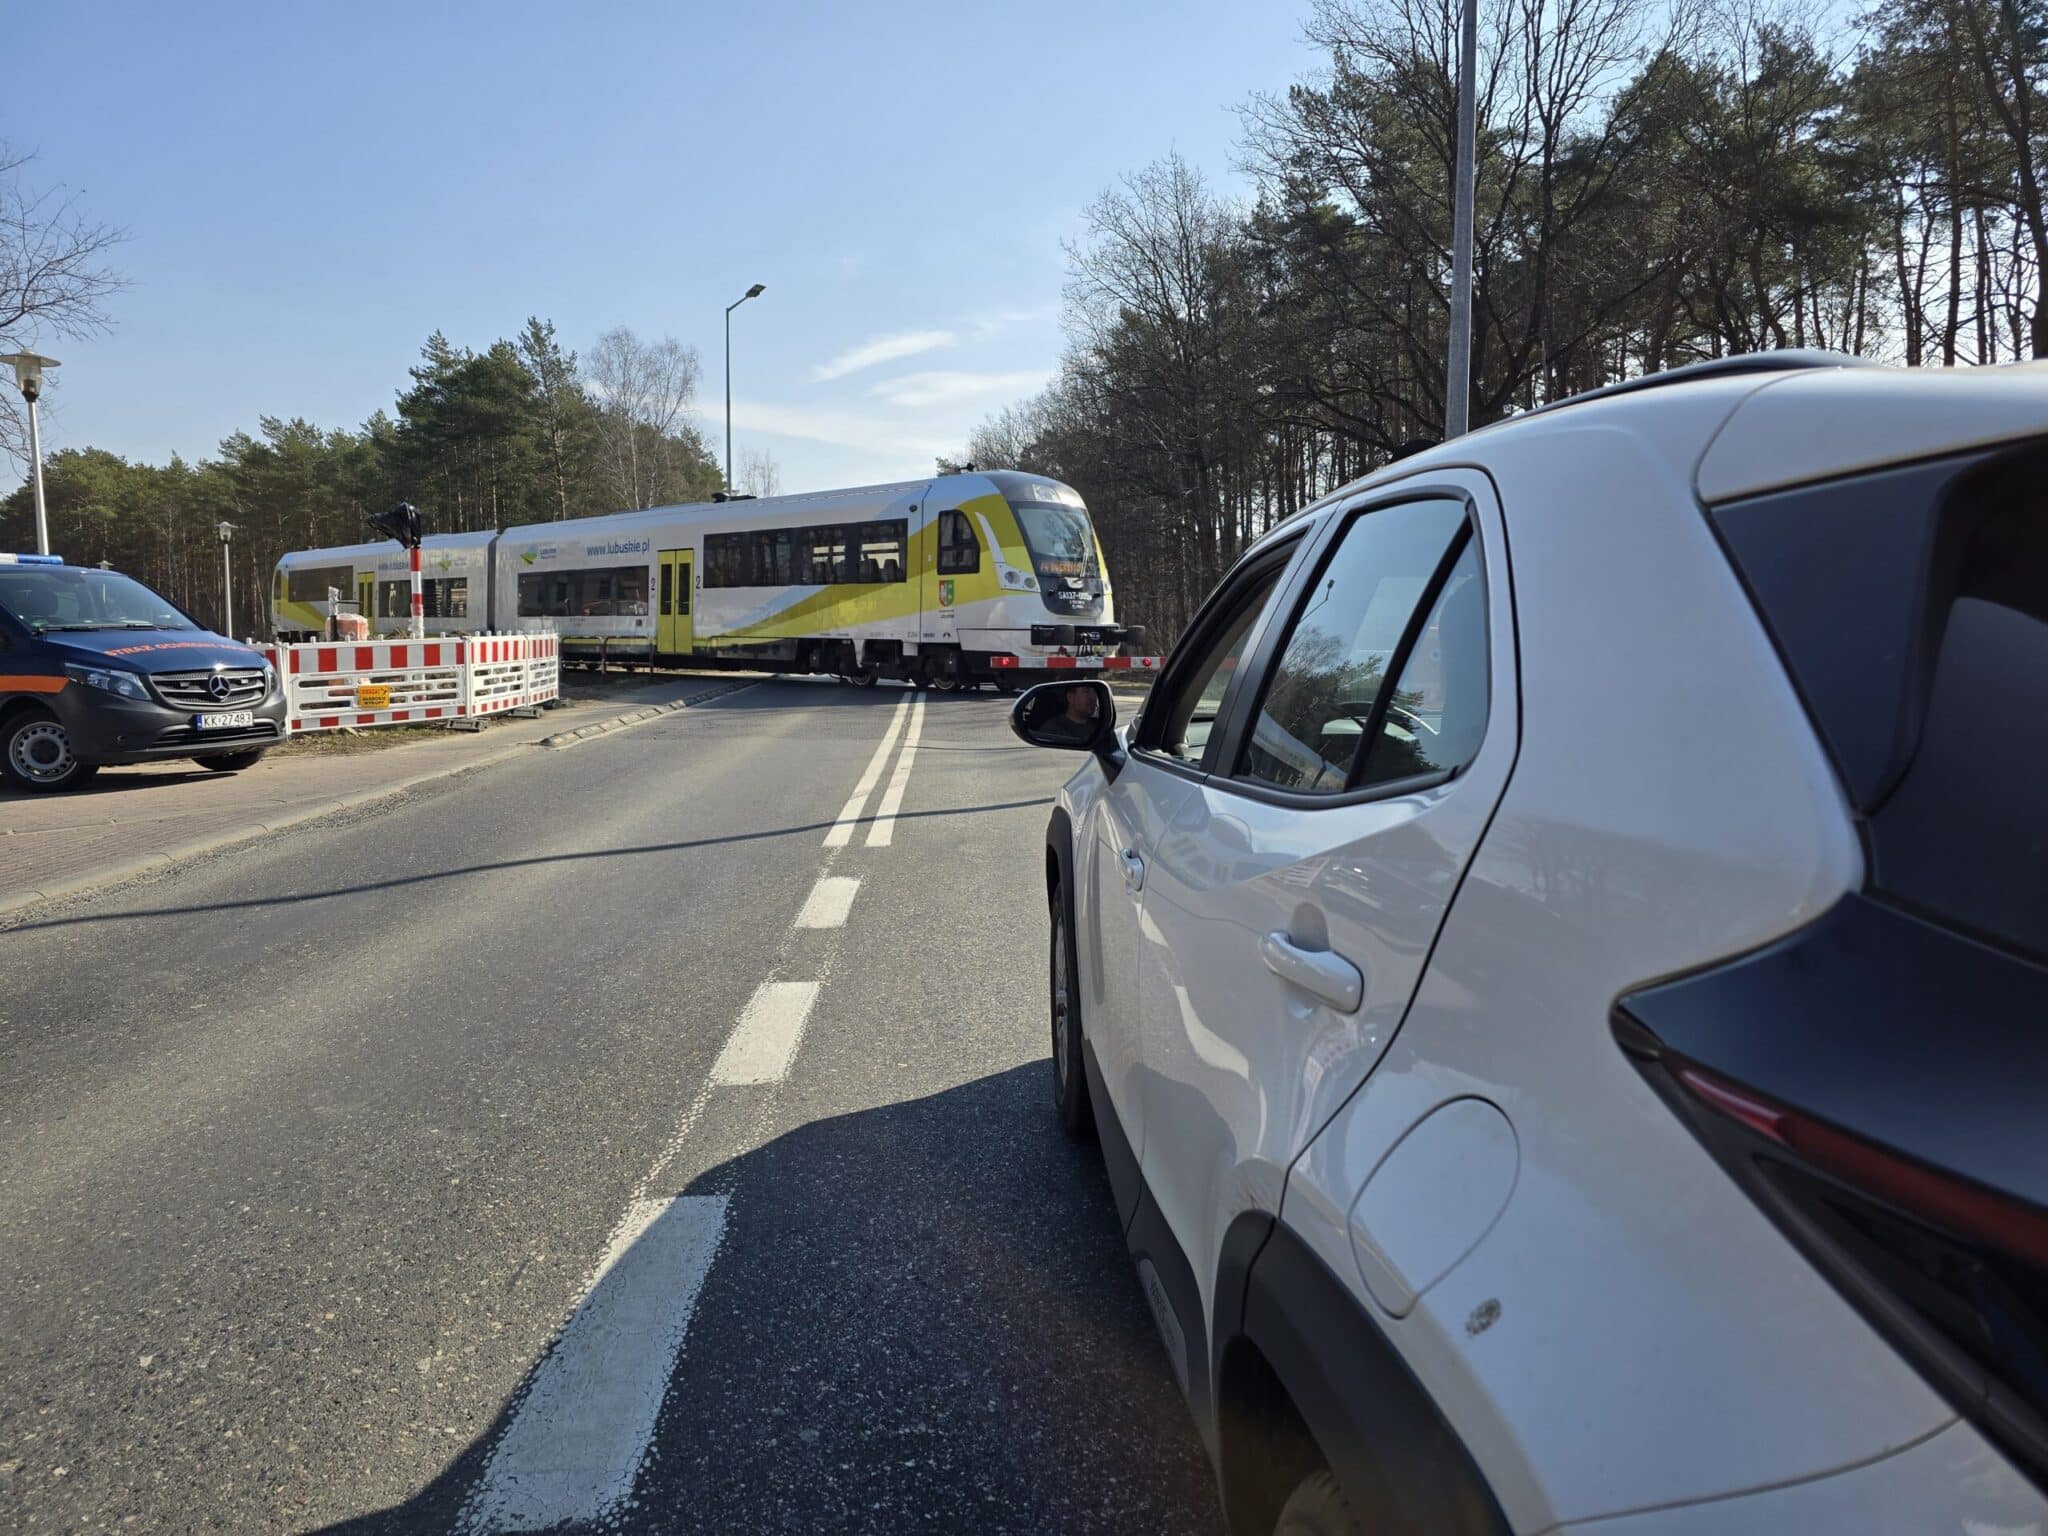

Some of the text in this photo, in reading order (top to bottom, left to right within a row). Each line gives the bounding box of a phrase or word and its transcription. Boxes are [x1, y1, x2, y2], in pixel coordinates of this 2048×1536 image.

[586, 538, 650, 557] www.lubuskie.pl
[650, 577, 656, 591] 2
[695, 575, 701, 590] 2
[204, 713, 251, 727] KK 27483
